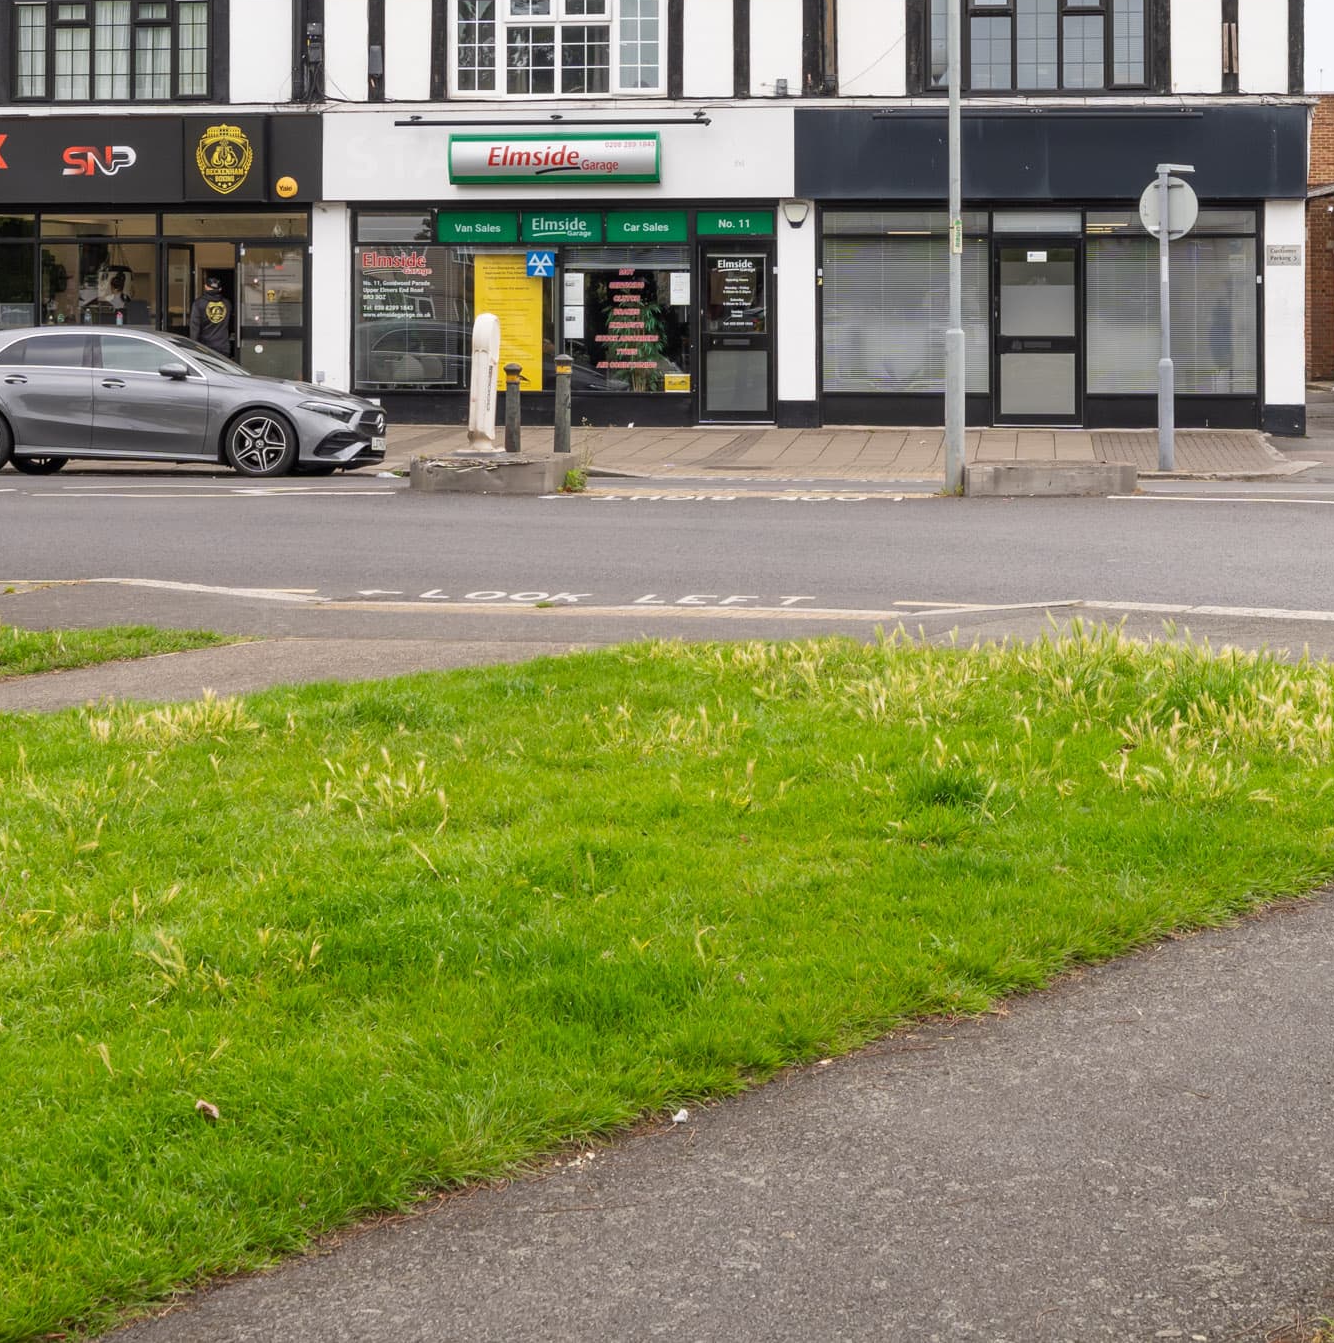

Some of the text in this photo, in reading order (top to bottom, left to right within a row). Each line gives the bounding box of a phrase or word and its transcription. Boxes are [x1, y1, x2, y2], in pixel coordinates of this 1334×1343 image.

[62, 145, 137, 176] SNP
[487, 146, 618, 173] Elmside Garage
[454, 223, 501, 233] Van Sales
[531, 217, 587, 231] Elmside
[623, 222, 669, 232] Car Sales
[718, 219, 750, 228] No. 11
[566, 230, 592, 238] Garage
[362, 251, 427, 268] Elmside
[717, 259, 753, 268] Elmside
[419, 588, 817, 607] LOOK LEFT
